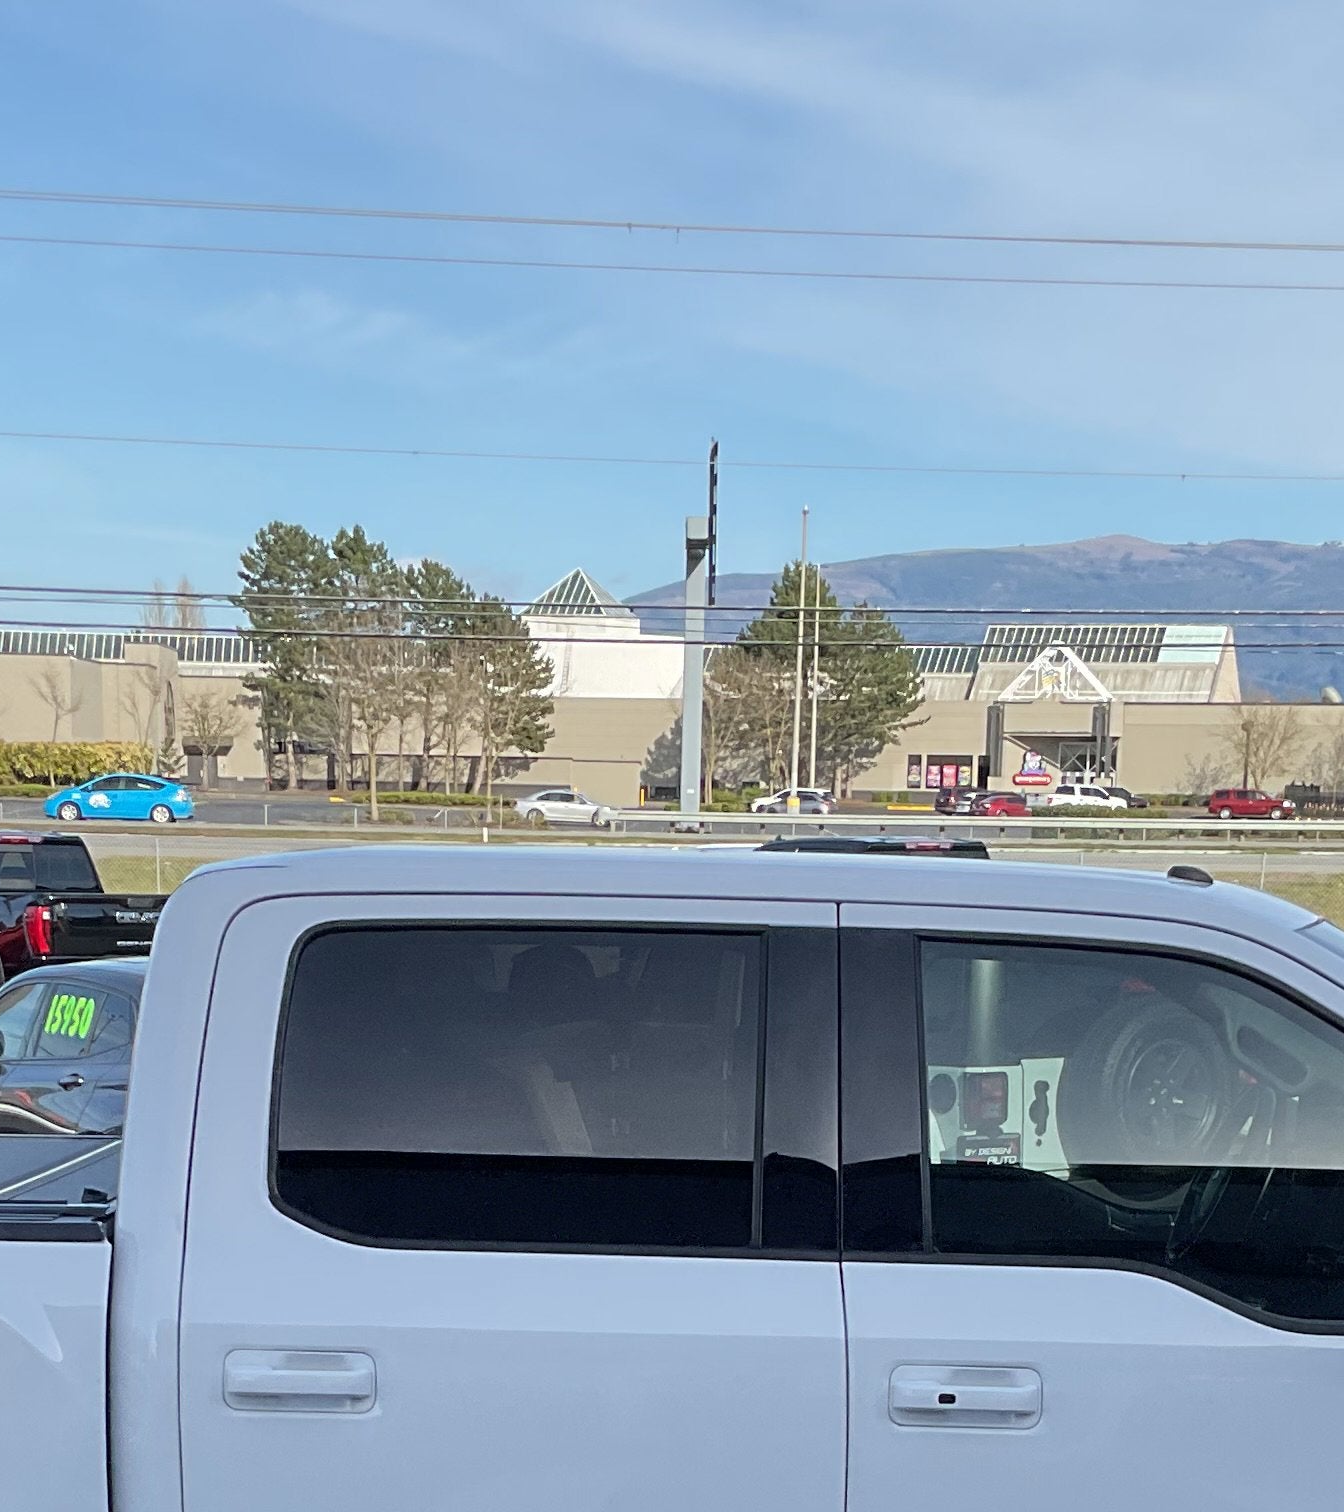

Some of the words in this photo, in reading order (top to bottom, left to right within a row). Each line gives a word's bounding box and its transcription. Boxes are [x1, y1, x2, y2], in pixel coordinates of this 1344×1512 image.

[44, 994, 95, 1039] 15950
[978, 1146, 1012, 1156] DESIGN
[987, 1156, 1017, 1165] AUTO
